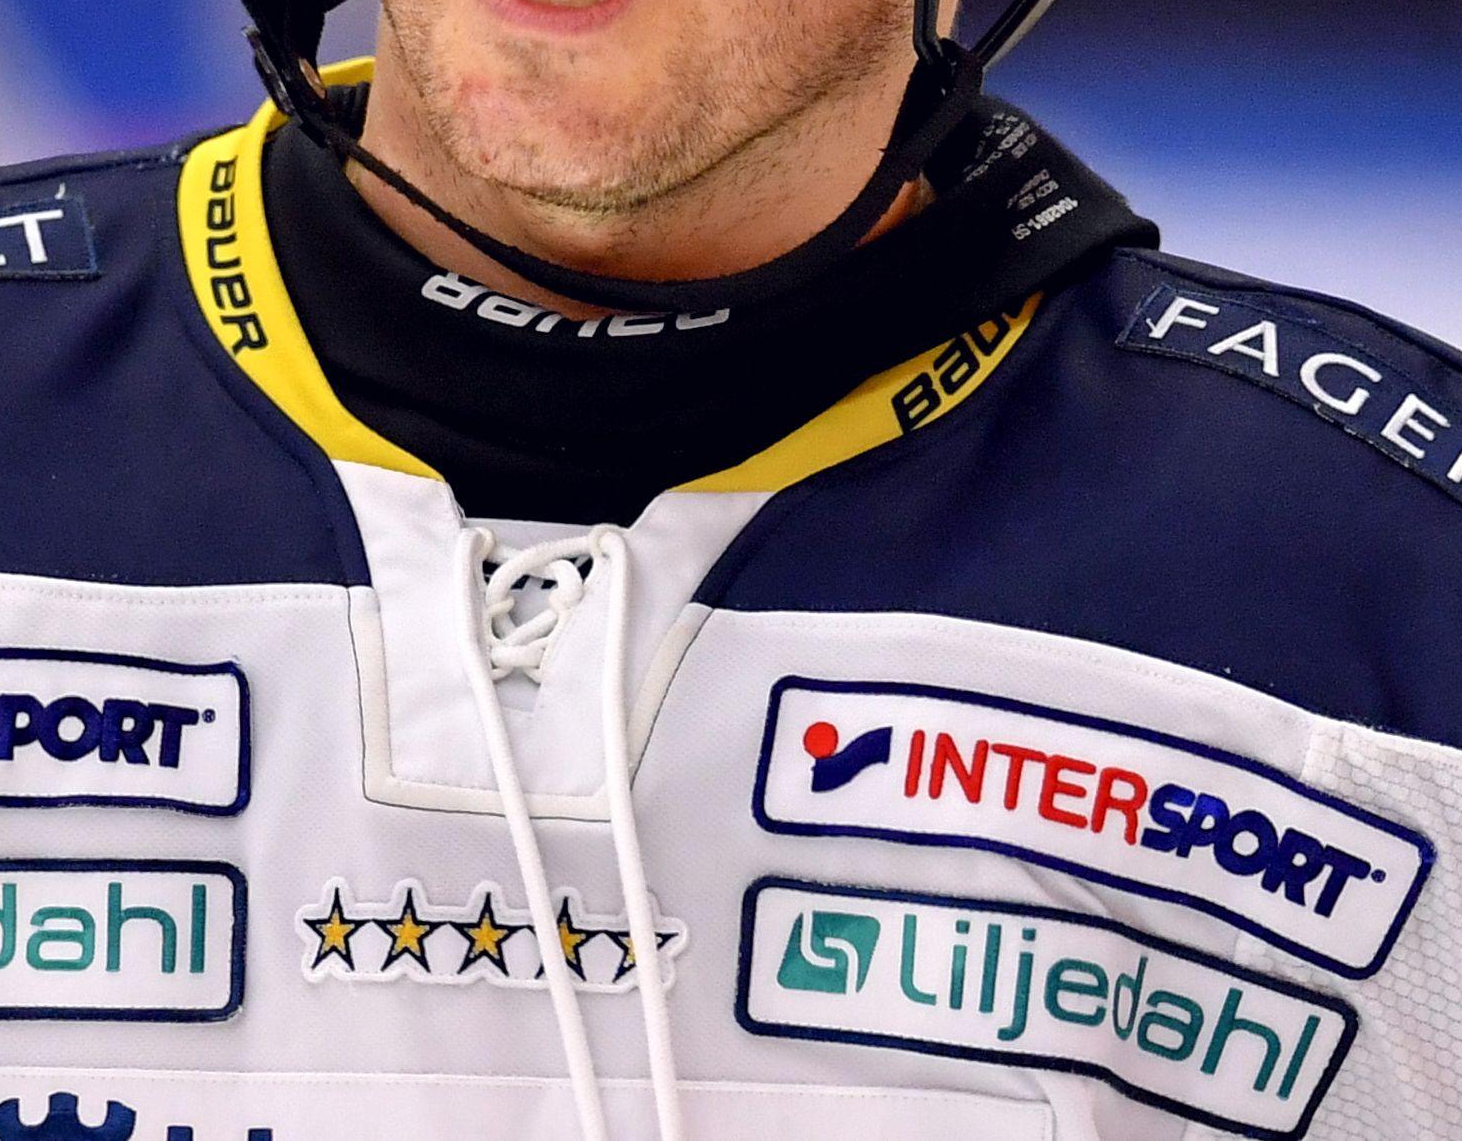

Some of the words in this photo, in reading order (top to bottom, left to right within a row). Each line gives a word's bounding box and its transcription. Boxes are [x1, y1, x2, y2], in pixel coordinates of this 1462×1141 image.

[206, 155, 269, 356] BAUER
[891, 312, 1011, 434] BAU
[903, 729, 1371, 918] INTERSPORT
[899, 913, 1321, 1101] Liljedahl
